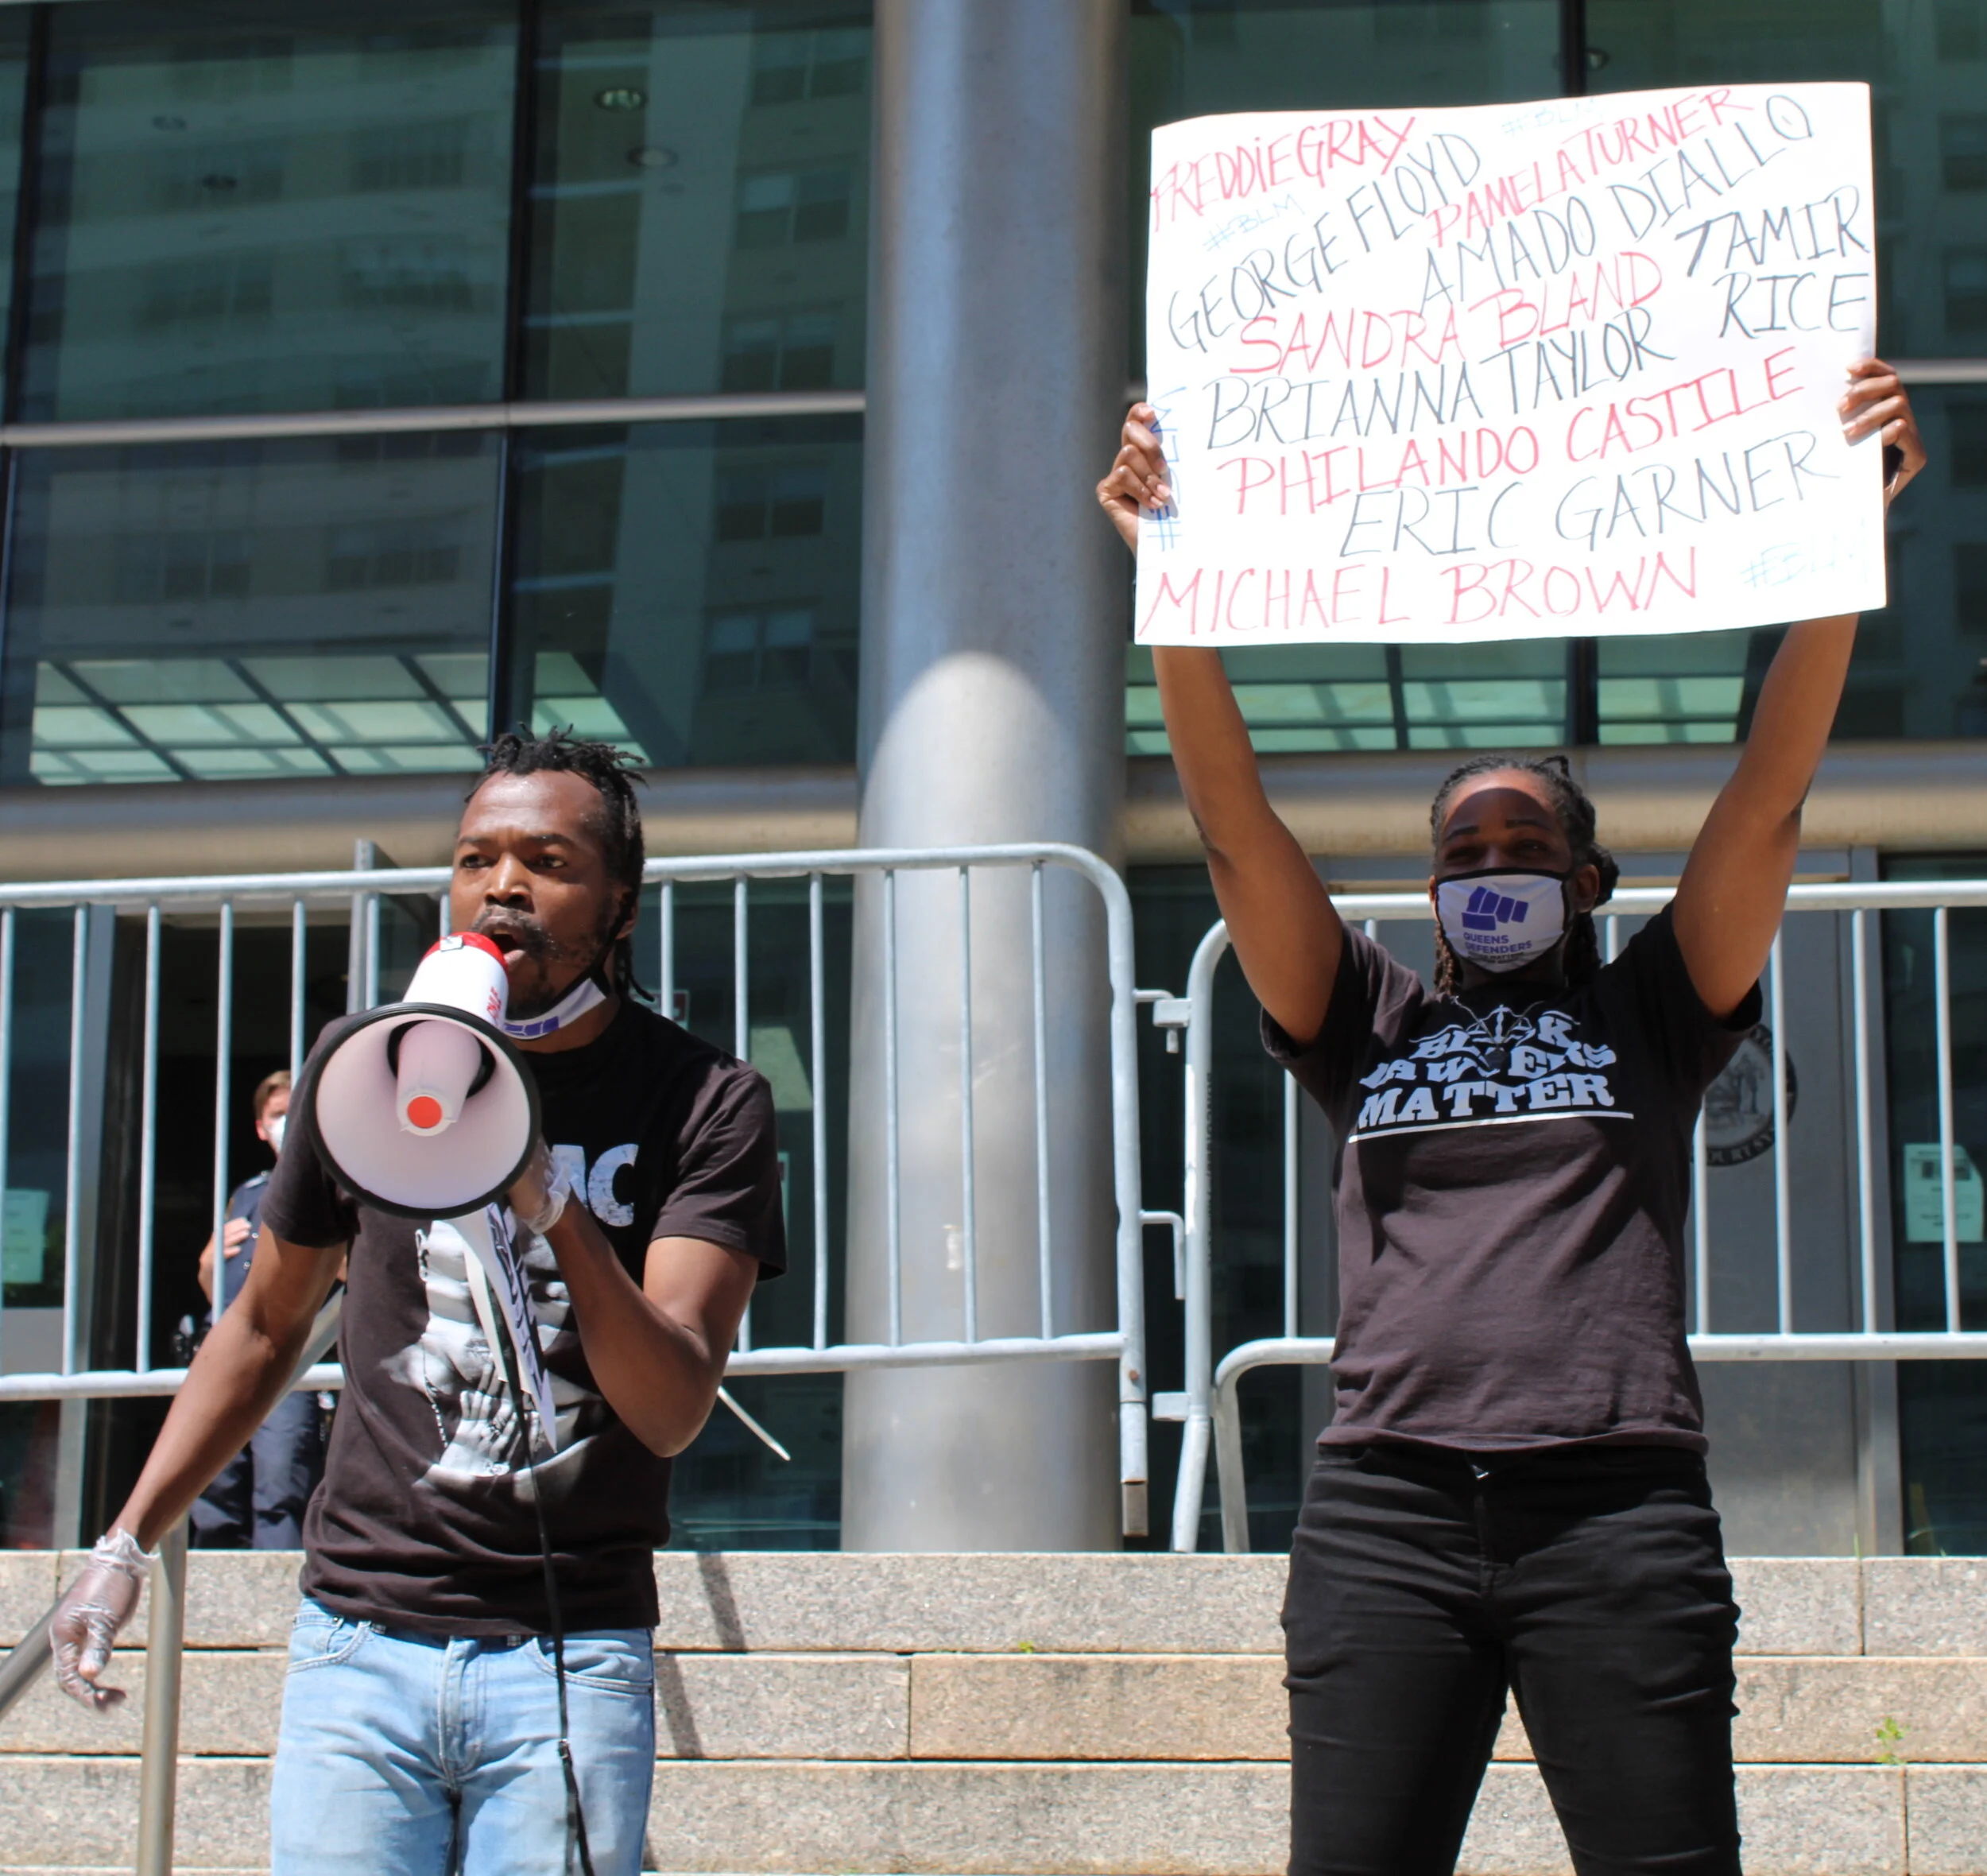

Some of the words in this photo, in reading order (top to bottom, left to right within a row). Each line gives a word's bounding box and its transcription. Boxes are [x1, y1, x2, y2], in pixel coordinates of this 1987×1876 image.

[1296, 115, 1416, 188] GRAY
[1168, 212, 1350, 353] GEORGE
[1346, 134, 1481, 253] FLOYD
[1202, 193, 1306, 252] #BLM
[1419, 196, 1596, 319] AMADO
[1605, 95, 1813, 243] DIALLO
[1674, 185, 1871, 277] TAMIR
[1229, 303, 1466, 376] SANDRA
[1468, 251, 1663, 352] BLAND
[1711, 271, 1870, 339] RICE
[1202, 362, 1484, 450] BRIANNA
[1478, 307, 1678, 414] TAYLOR
[1216, 425, 1540, 516] PHILANDO
[1566, 347, 1805, 462] CASTILE
[1339, 482, 1524, 557] ERIC
[1555, 430, 1841, 552] GARNER
[1137, 564, 1412, 637] MICHAEL
[1439, 545, 1697, 625] BROWN
[1463, 932, 1509, 944] QUEENS
[1358, 1073, 1615, 1130] MATTER
